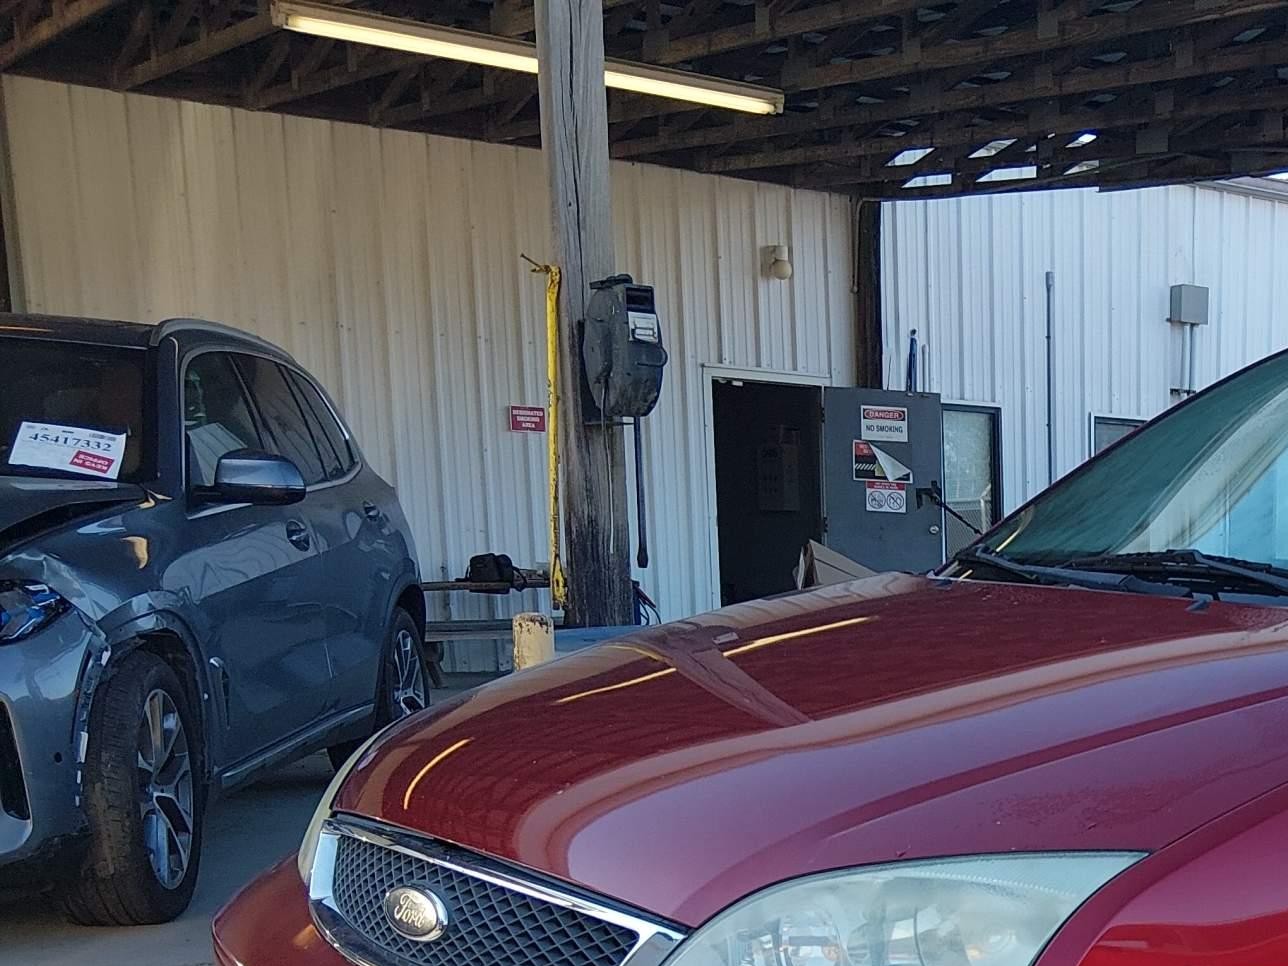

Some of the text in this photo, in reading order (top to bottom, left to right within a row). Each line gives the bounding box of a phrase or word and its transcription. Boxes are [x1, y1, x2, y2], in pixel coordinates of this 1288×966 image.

[869, 411, 899, 419] DANGER
[865, 424, 903, 433] NO SMOKING
[29, 432, 112, 452] 45417332
[394, 893, 426, 929] Ford
